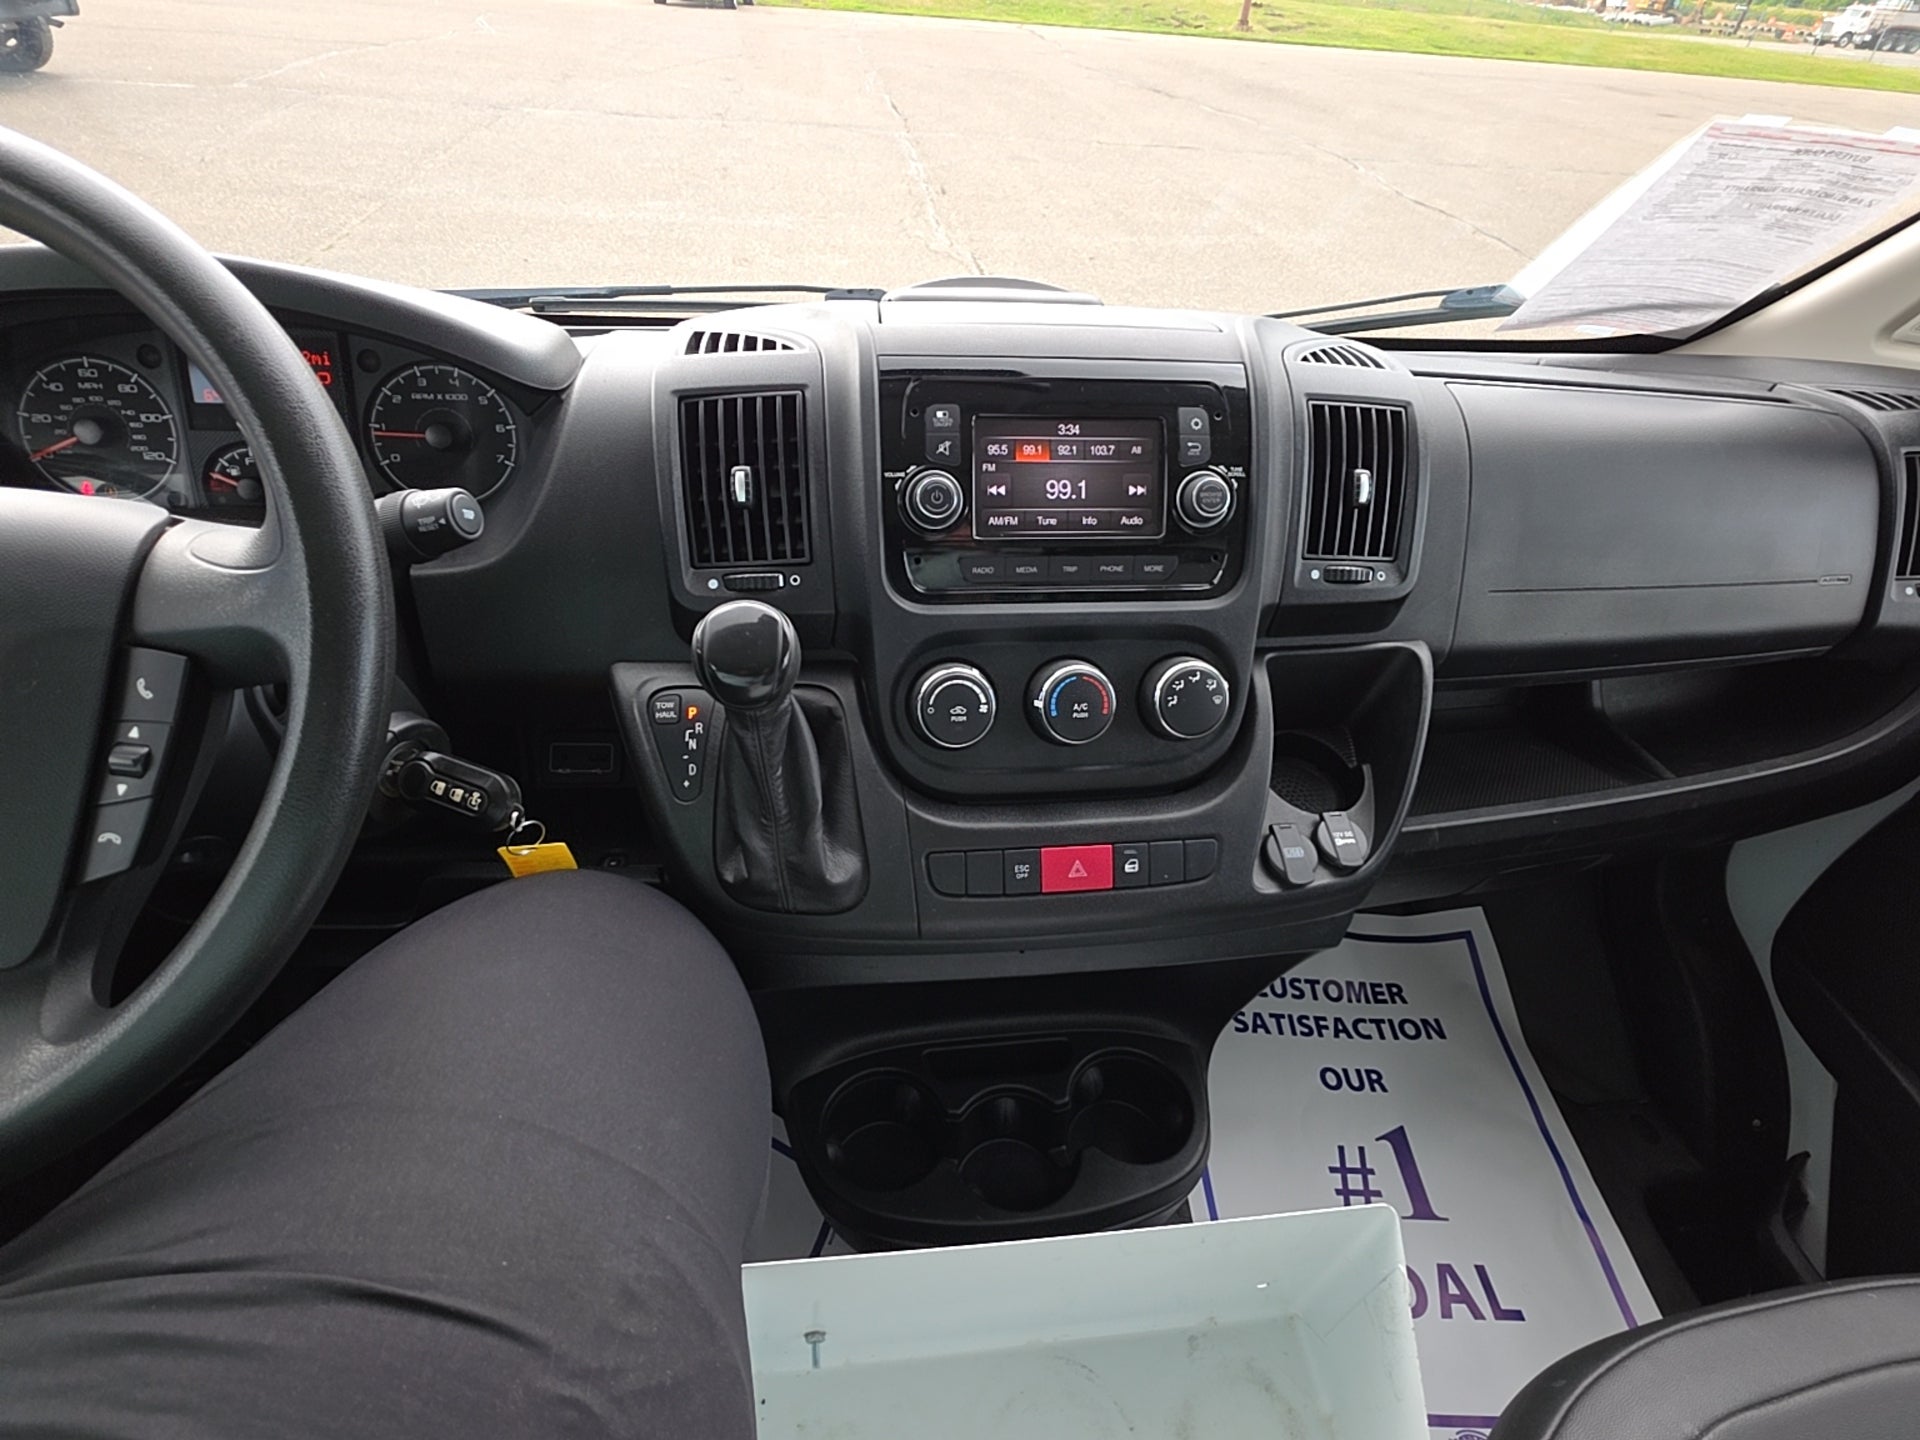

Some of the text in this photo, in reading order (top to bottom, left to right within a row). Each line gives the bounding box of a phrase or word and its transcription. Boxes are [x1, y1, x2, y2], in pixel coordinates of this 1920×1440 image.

[418, 377, 427, 387] 3
[449, 378, 460, 387] 4
[139, 413, 163, 423] 100
[495, 424, 506, 433] 6
[1057, 424, 1080, 435] 3:34
[987, 444, 1009, 455] 95.5
[1022, 444, 1042, 455] 99.1
[1057, 444, 1077, 455] 92.1
[1090, 444, 1116, 456] 103.7
[982, 463, 996, 472] FM
[1045, 479, 1086, 500] 99.1
[988, 516, 1143, 526] AM/FM Tune Info Audio
[972, 564, 1164, 575] RADIO MEDIA TRIP PHONE MORE
[1072, 703, 1088, 711] A/C
[655, 711, 677, 719] HAUL
[687, 706, 697, 720] P
[695, 722, 703, 734] R
[688, 738, 697, 750] N
[688, 763, 697, 776] D
[1015, 864, 1030, 873] ESC
[1232, 1011, 1448, 1041] SATISFACTION
[1319, 1066, 1389, 1093] OUR
[1328, 1125, 1450, 1221] #1
